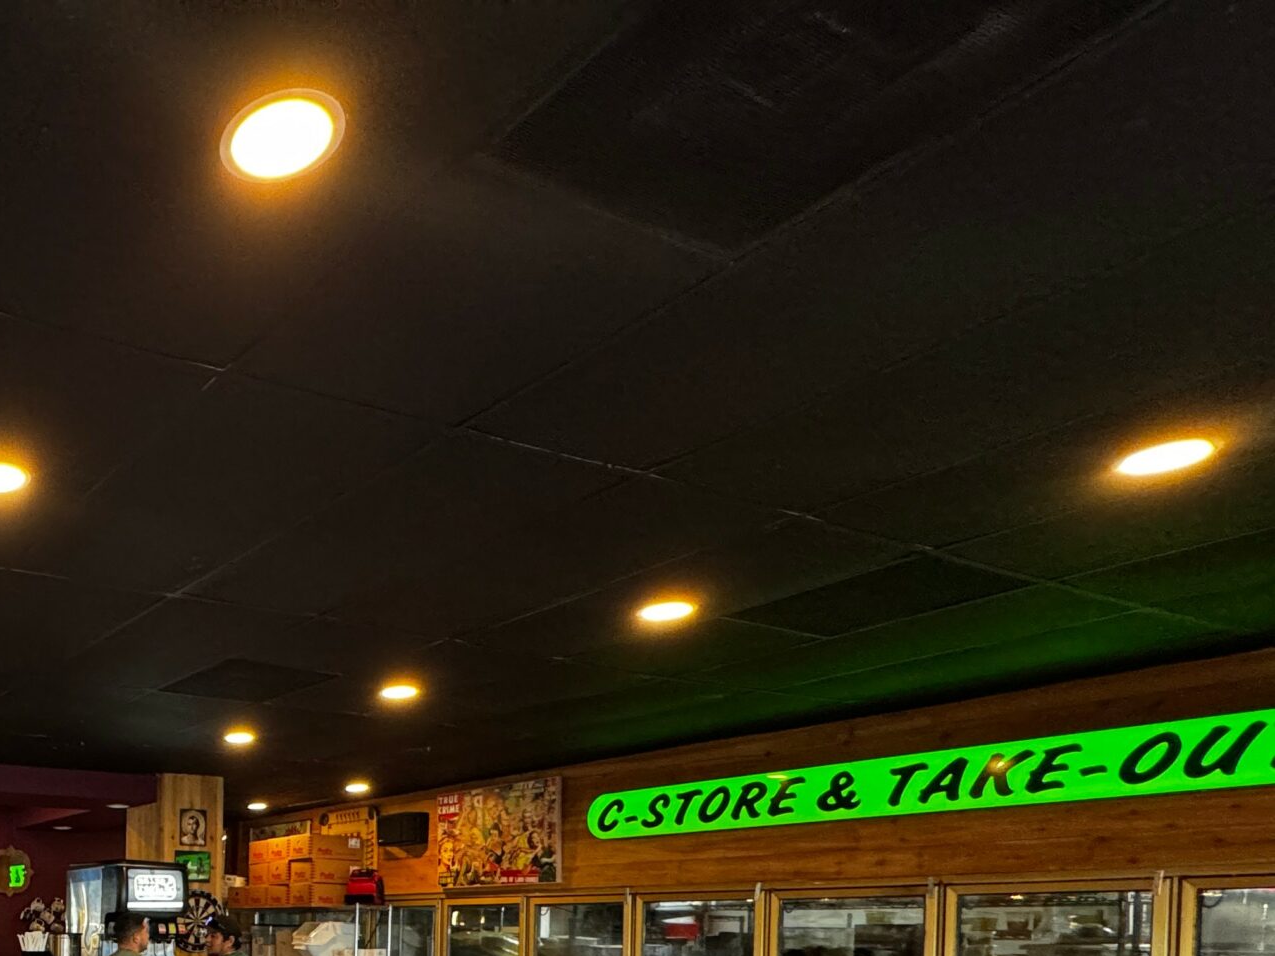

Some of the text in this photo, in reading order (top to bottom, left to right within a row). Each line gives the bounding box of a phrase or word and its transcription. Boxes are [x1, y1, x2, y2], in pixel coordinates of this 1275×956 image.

[438, 794, 459, 805] TRUE
[597, 720, 1275, 832] C-STORE & TAKE-OU
